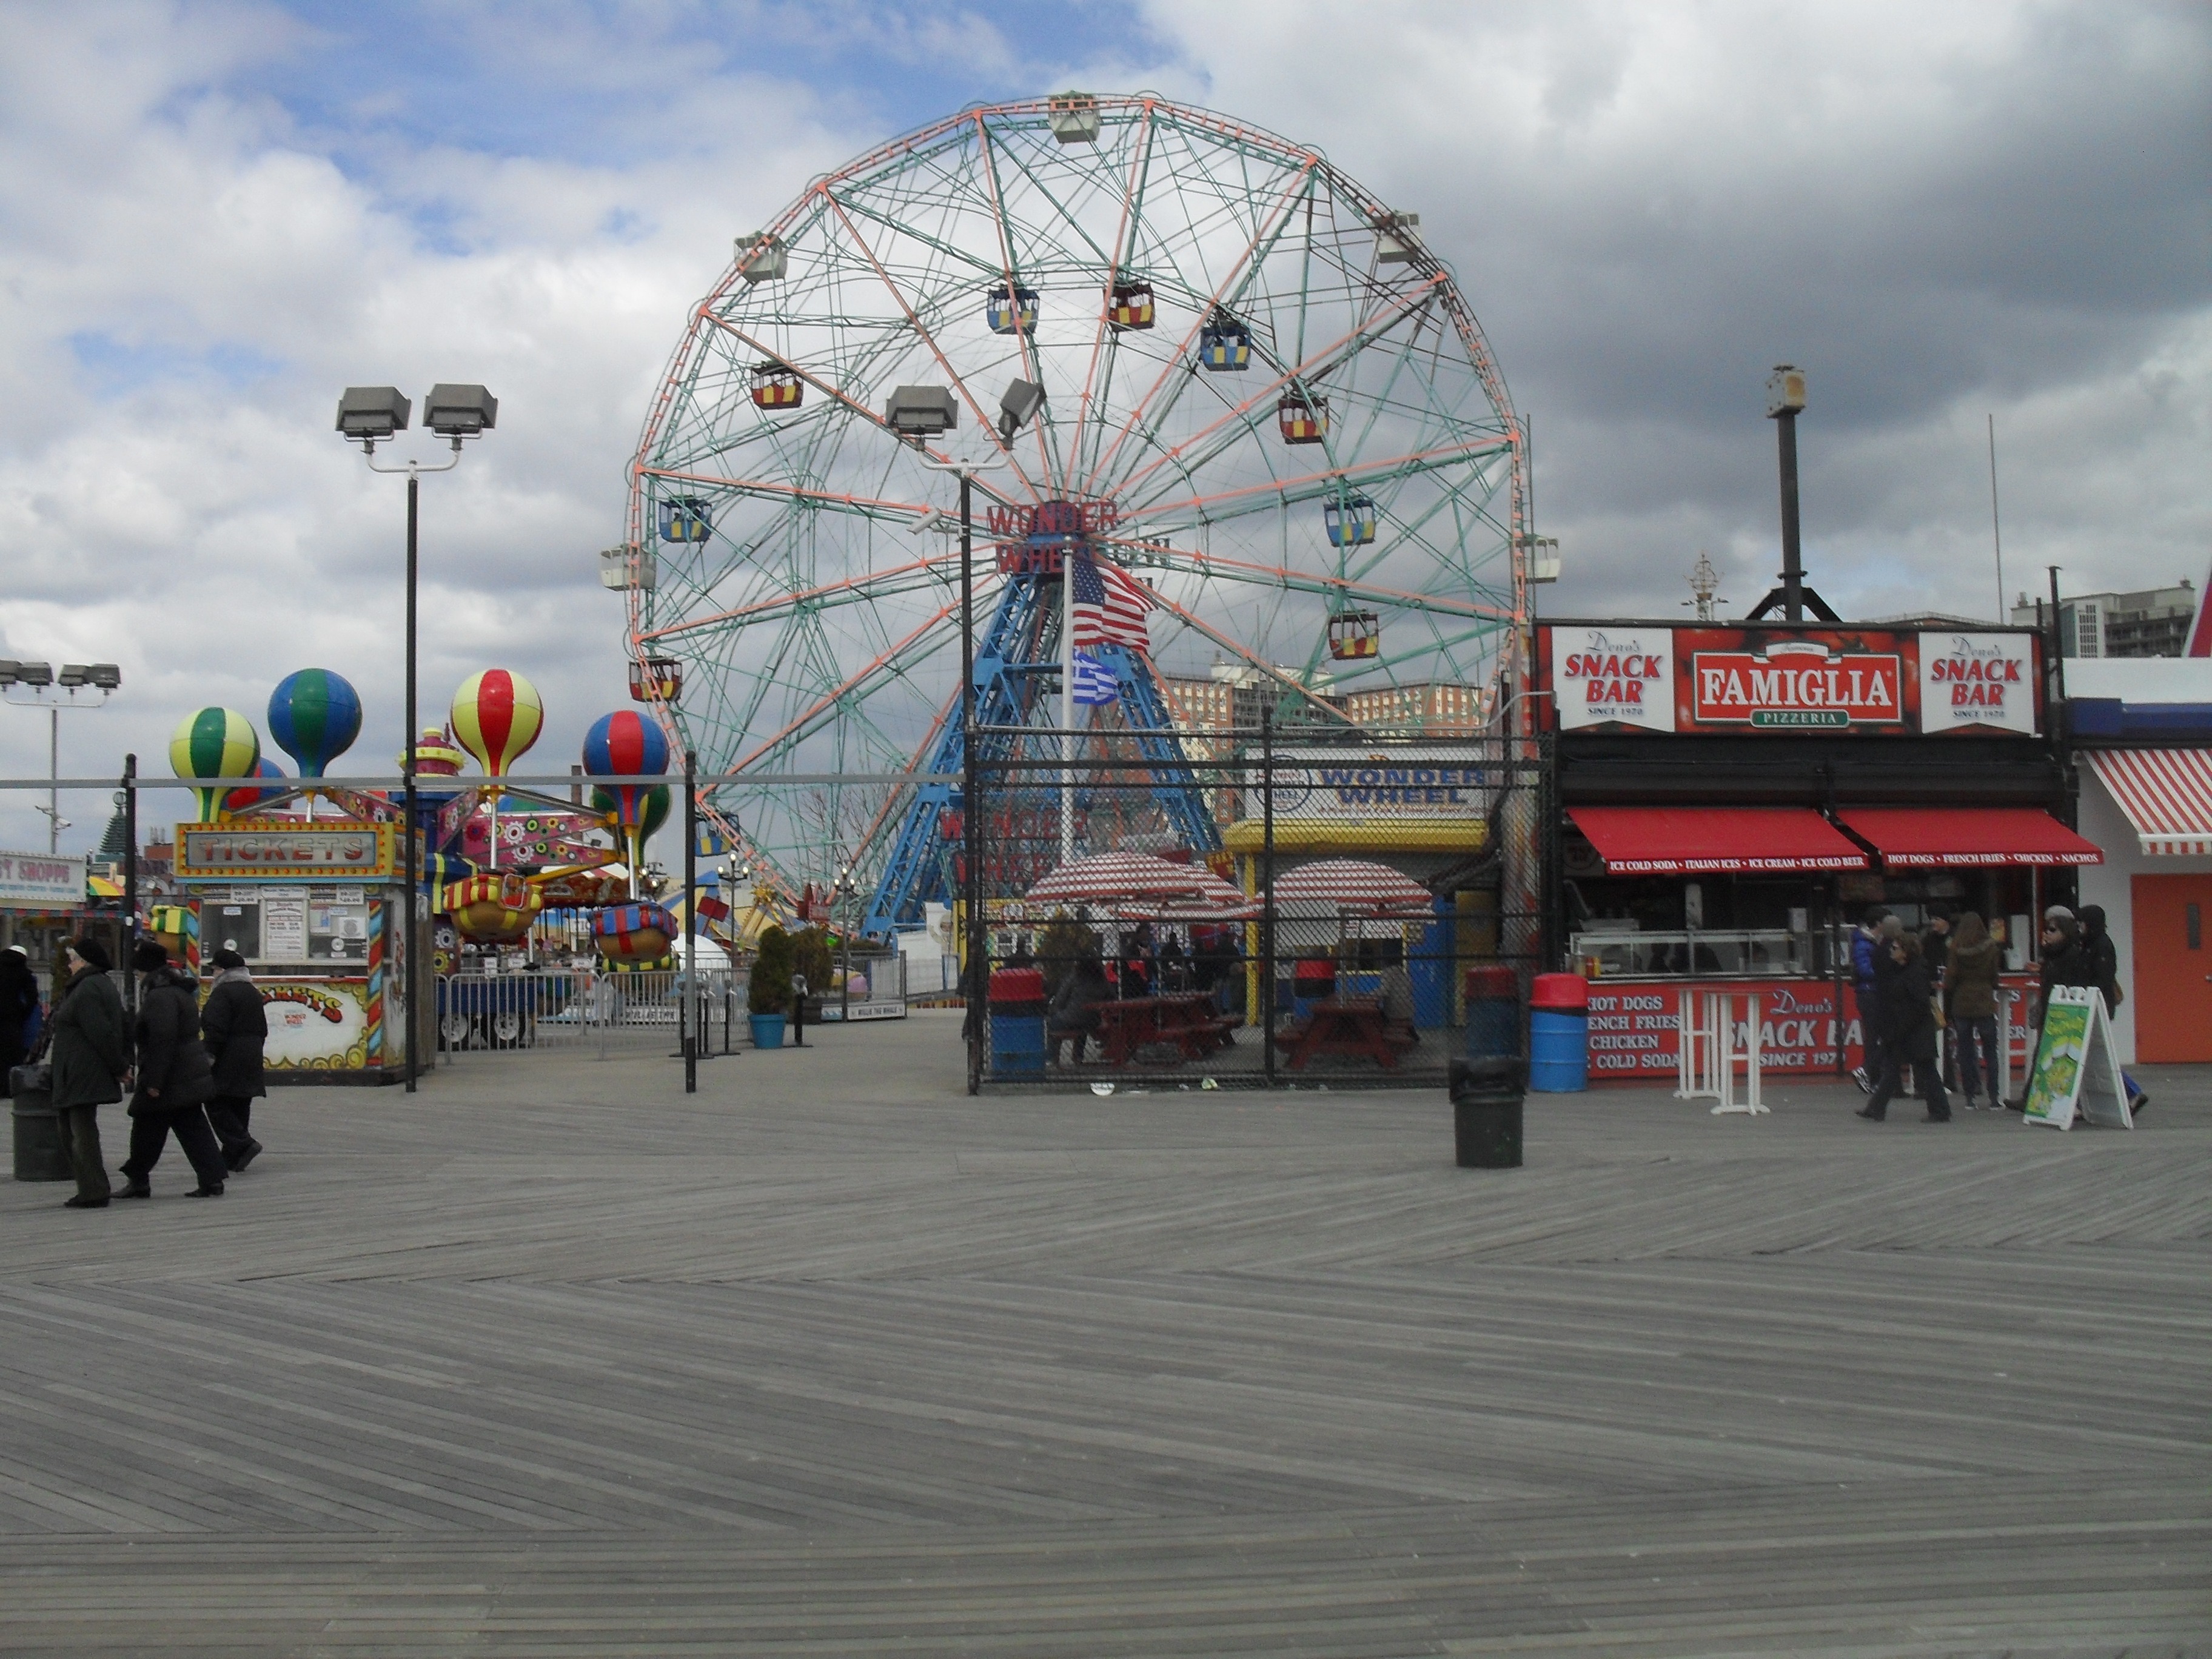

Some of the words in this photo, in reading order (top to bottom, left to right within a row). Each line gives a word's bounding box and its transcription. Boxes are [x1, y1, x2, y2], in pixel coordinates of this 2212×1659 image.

[987, 501, 1117, 535] WONDER
[1564, 654, 1663, 679] SNACK
[1931, 659, 2022, 682] SNACK
[1586, 680, 1643, 703] BAR
[1700, 669, 1892, 706] FAMIGLIA
[1951, 683, 2004, 705] BAR
[1762, 712, 1837, 723] PIZZERIA
[1321, 767, 1485, 784] WONDER
[1338, 788, 1469, 803] WHEEL
[198, 838, 363, 861] TICKETS
[1610, 860, 1626, 871] ICE
[1626, 860, 1652, 871] COLD
[1652, 860, 1678, 870] SODA
[1684, 859, 1720, 869] ITALIAN
[1720, 859, 1741, 868] ICES
[1748, 858, 1764, 868] ICE
[1765, 858, 1796, 868] CREAM
[1801, 857, 1817, 867] ICE
[1817, 857, 1842, 866] COLD
[1842, 856, 1865, 866] BEER
[1888, 854, 1908, 863] HOT
[1909, 854, 1936, 863] DOGS
[1942, 853, 1980, 863] FRENCH
[1980, 853, 2006, 863] FRIES
[2013, 853, 2054, 863] CHICKEN
[2061, 853, 2099, 863] NACHOS
[1622, 996, 1663, 1011] DOGS
[1770, 989, 1832, 1014] Deno's
[1587, 1016, 1630, 1030] ENCH
[1635, 1014, 1680, 1030] FRIES
[1589, 1034, 1659, 1050] CHICKEN
[1597, 1054, 1637, 1069] COLD
[1759, 1052, 1806, 1067] SINCE
